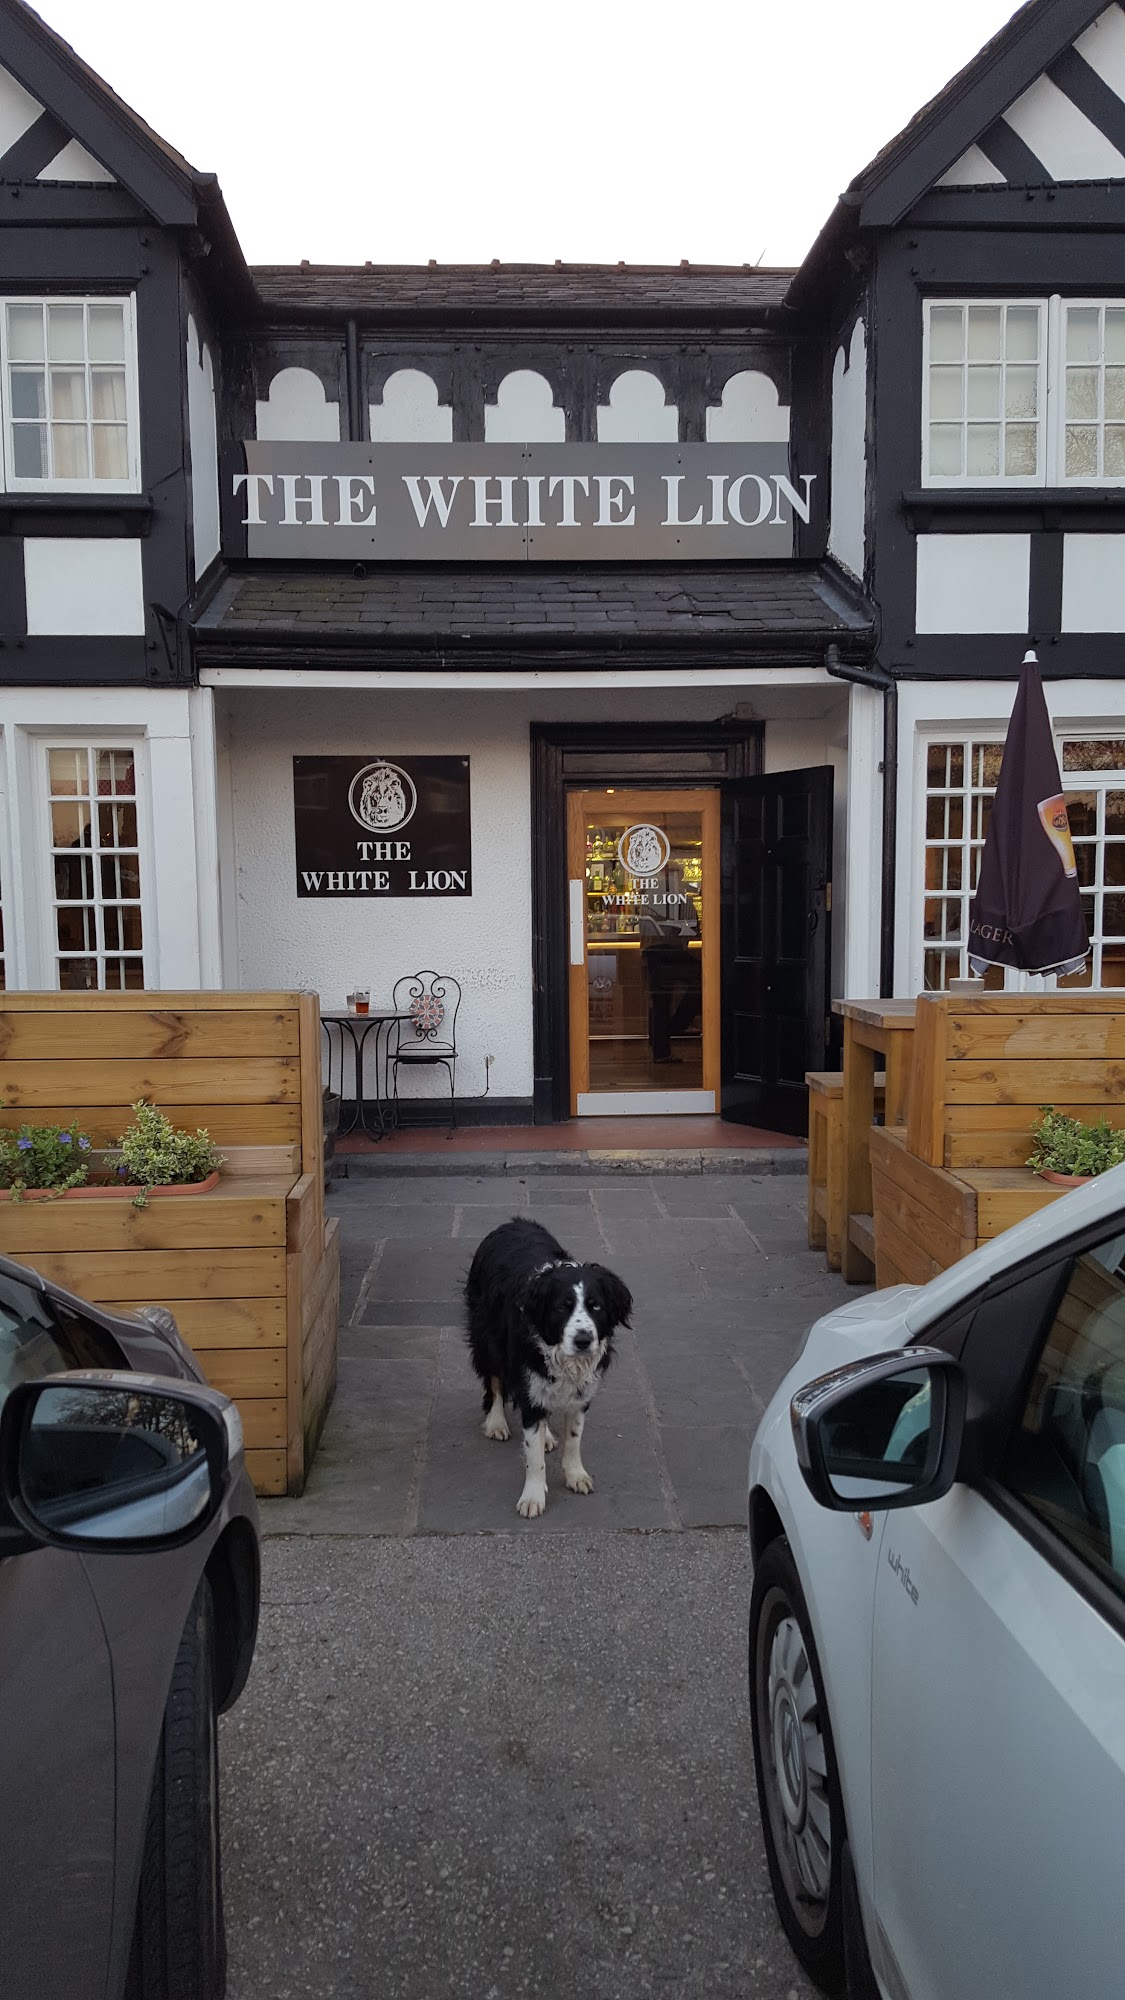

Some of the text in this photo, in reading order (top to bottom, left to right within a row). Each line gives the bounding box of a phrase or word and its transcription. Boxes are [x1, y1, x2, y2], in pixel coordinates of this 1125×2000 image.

[232, 473, 817, 528] THE WHITE LION
[357, 841, 411, 861] THE
[301, 870, 468, 891] WHITE LION
[631, 878, 659, 889] THE
[602, 893, 687, 905] WHITE LION
[970, 919, 1013, 945] LAGER
[888, 1548, 919, 1606] white
